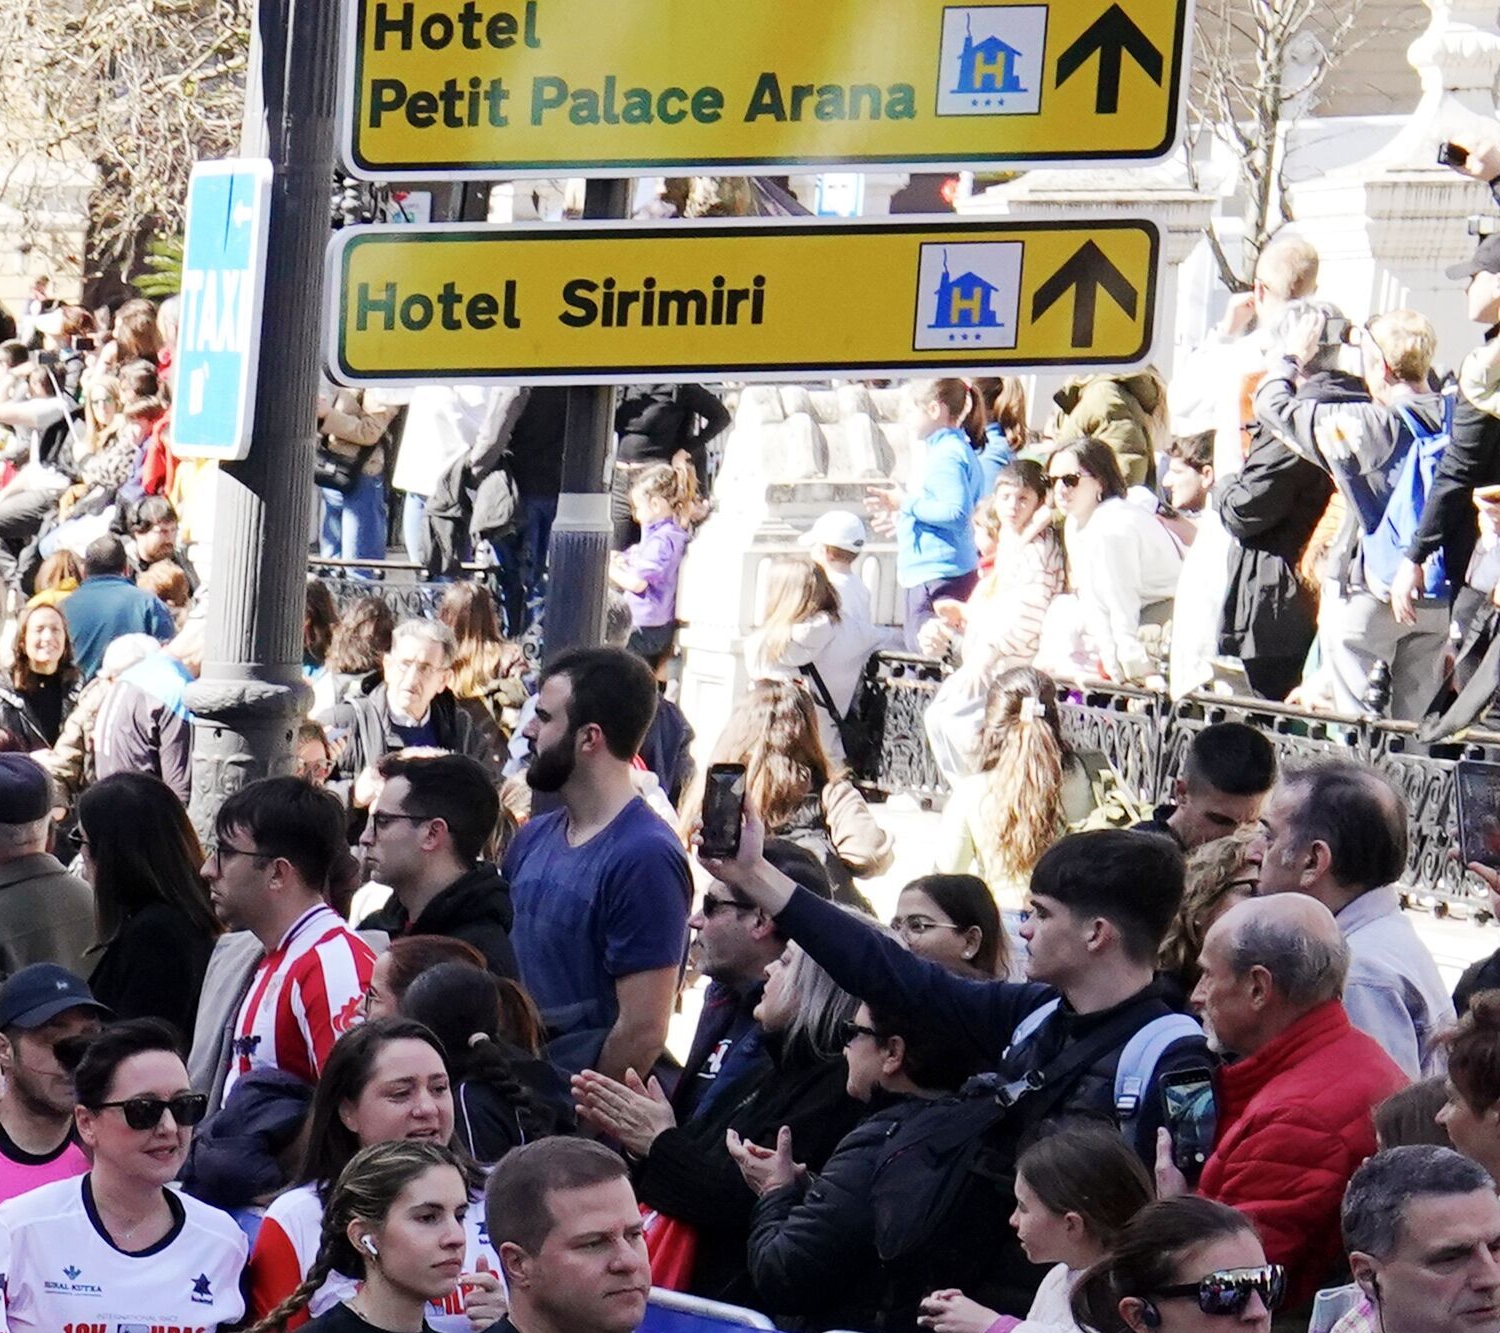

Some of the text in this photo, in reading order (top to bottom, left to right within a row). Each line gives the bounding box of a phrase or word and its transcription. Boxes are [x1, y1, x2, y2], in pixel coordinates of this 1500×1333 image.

[371, 0, 541, 51] Hotel
[369, 71, 916, 130] Petit Palace Arana
[355, 274, 766, 335] Hotel Sirimiri
